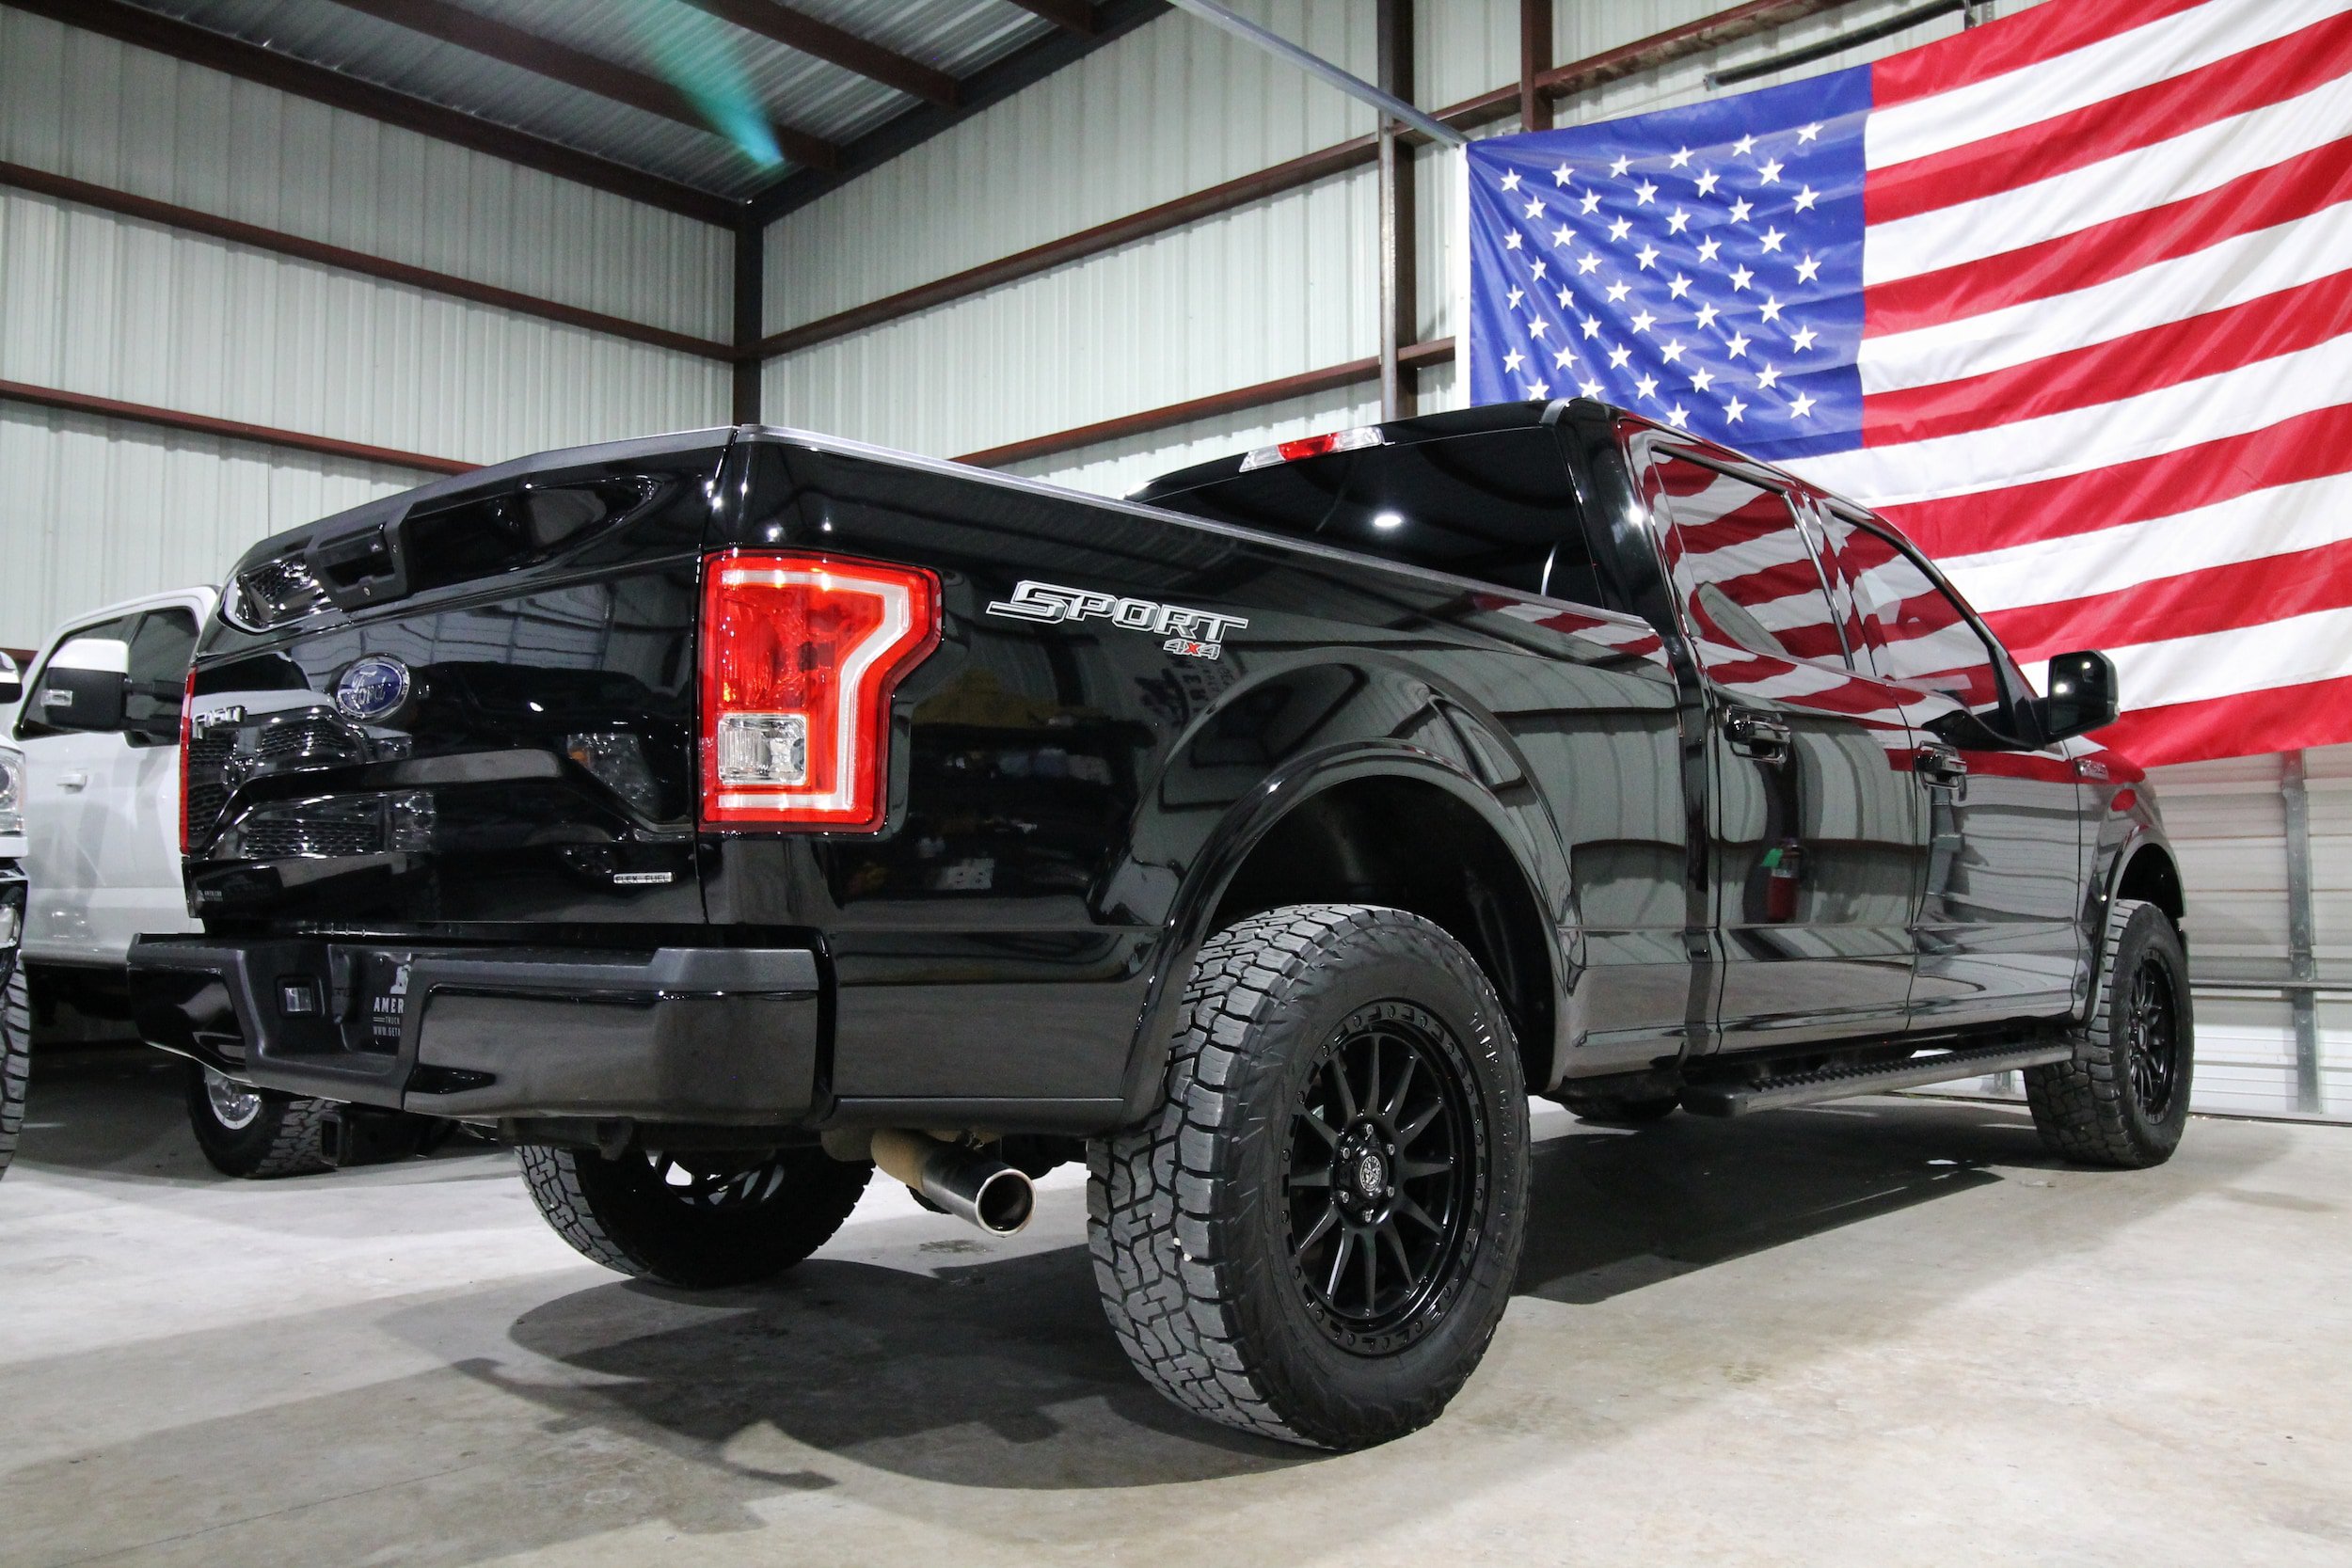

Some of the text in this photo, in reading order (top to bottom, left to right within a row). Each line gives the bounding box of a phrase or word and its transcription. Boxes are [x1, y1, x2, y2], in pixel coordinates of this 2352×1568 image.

[986, 579, 1249, 643] SPORT
[615, 874, 670, 883] FLEX FUEL
